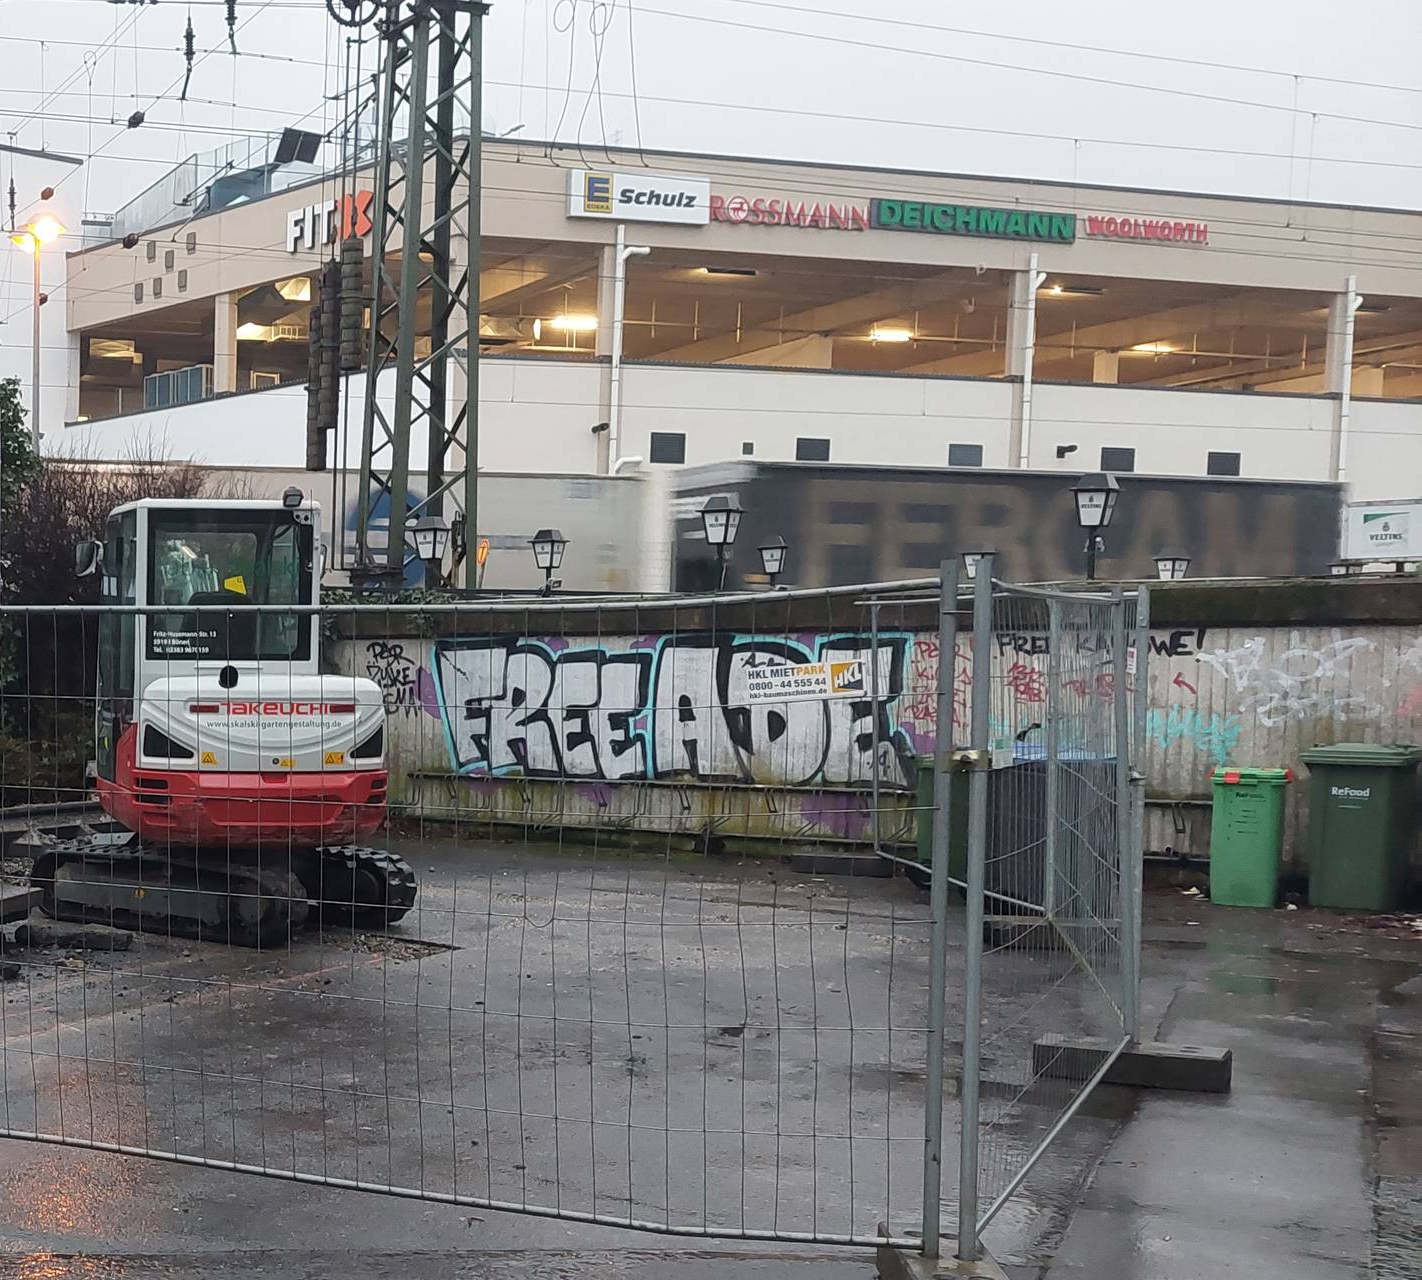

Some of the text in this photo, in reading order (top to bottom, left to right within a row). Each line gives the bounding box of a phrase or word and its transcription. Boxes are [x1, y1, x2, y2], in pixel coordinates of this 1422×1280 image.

[618, 188, 697, 208] Schulz
[710, 195, 870, 232] ROSSMANN
[880, 199, 1073, 239] DEICHMANN
[1086, 215, 1209, 242] WOOLWORTH
[1369, 533, 1403, 541] VELTINS
[748, 665, 826, 680] HKL MIETPARK
[793, 678, 813, 688] 555
[814, 677, 827, 687] 44
[833, 663, 862, 688] HKL
[1331, 786, 1370, 797] ReFood
